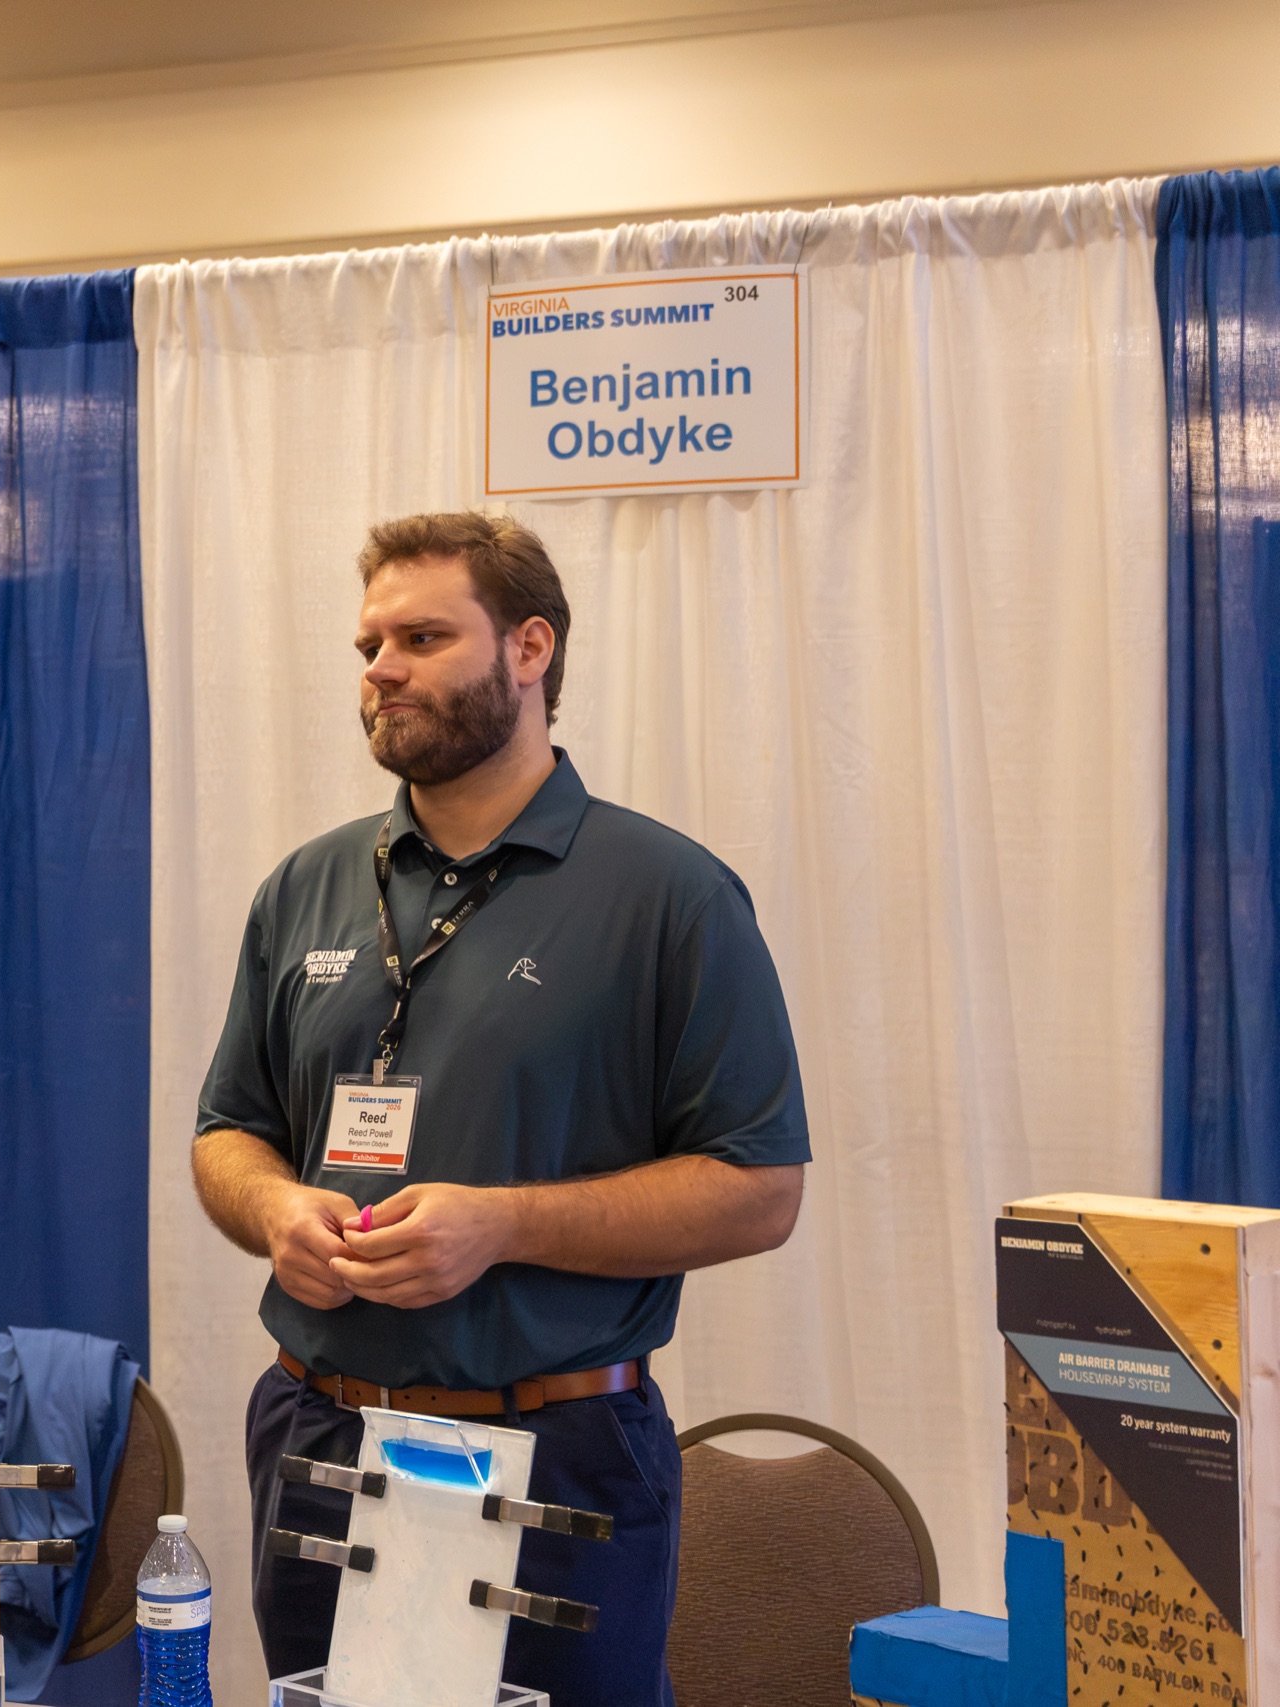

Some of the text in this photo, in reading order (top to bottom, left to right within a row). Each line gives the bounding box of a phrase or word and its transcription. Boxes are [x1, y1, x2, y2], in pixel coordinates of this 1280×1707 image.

[724, 285, 759, 302] 304
[494, 297, 570, 317] VIRGINIA
[492, 303, 715, 338] BUILDERS SUMMIT
[530, 358, 751, 412] Benjamin
[547, 415, 733, 465] Obdyke
[304, 949, 358, 962] BENJAMIN
[306, 962, 350, 976] OBDYKE
[359, 1111, 387, 1124] Reed
[348, 1127, 393, 1138] Reed Powell
[348, 1139, 370, 1147] Benjamin
[352, 1153, 380, 1162] Exhibitor
[1001, 1236, 1084, 1254] BENJAMIN OBDYKE
[1058, 1352, 1171, 1378] AIR BARRIER DRAINABLE
[1059, 1368, 1170, 1393] HOUSEWRAP SYSTEM
[1120, 1414, 1231, 1444] 20 year system warranty
